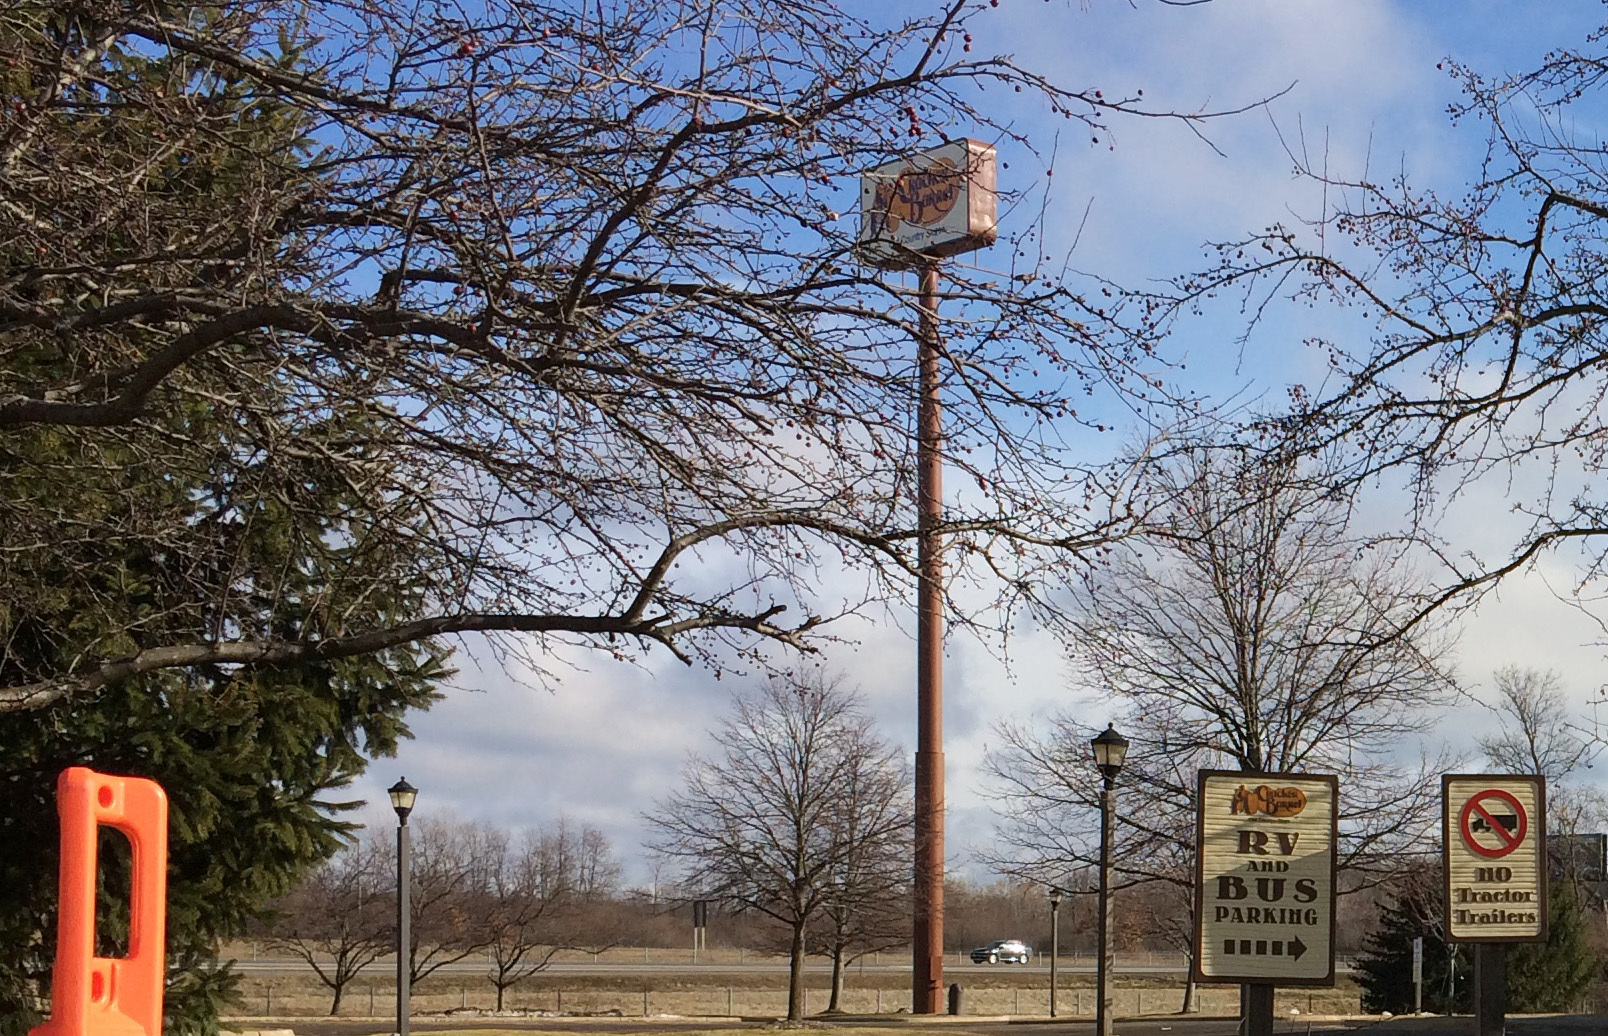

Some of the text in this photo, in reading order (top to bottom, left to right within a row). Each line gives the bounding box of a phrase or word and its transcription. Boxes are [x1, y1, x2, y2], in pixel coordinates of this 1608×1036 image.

[1236, 830, 1300, 856] RV
[1246, 860, 1289, 873] AND
[1477, 866, 1513, 883] NO
[1215, 875, 1318, 904] BUS
[1455, 887, 1534, 904] Tractor
[1214, 905, 1319, 926] PARKING
[1454, 908, 1537, 925] Trailers
